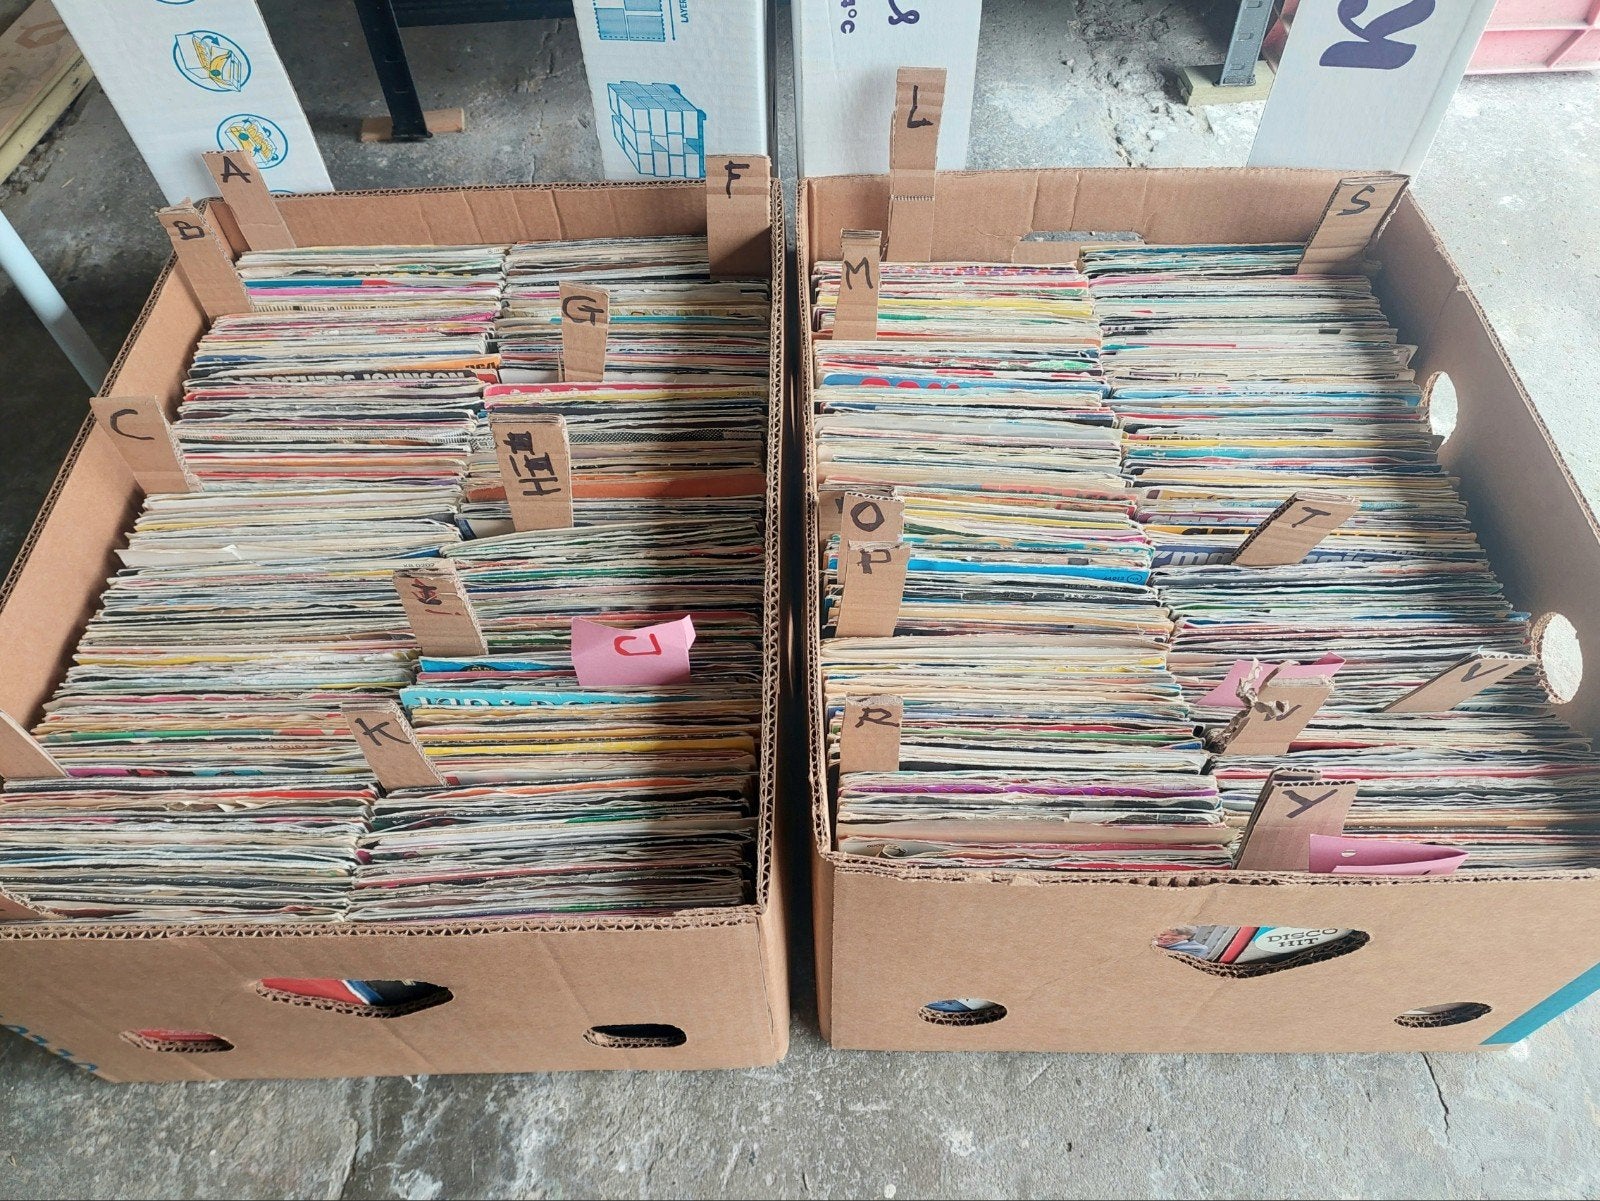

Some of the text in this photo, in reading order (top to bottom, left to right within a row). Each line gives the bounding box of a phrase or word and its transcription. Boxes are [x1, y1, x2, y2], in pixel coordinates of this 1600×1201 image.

[906, 85, 934, 129] L
[220, 156, 251, 184] A
[724, 160, 751, 199] F
[1336, 184, 1376, 216] S
[174, 219, 206, 241] B
[844, 257, 874, 291] M
[561, 294, 604, 326] G
[109, 408, 154, 440] C
[850, 501, 885, 532] O
[1291, 506, 1332, 528] T
[856, 547, 892, 574] P
[354, 717, 410, 747] K
[855, 707, 899, 728] R
[1281, 788, 1338, 819] Y
[1265, 928, 1339, 942] DISCO
[1278, 937, 1319, 947] HIT
